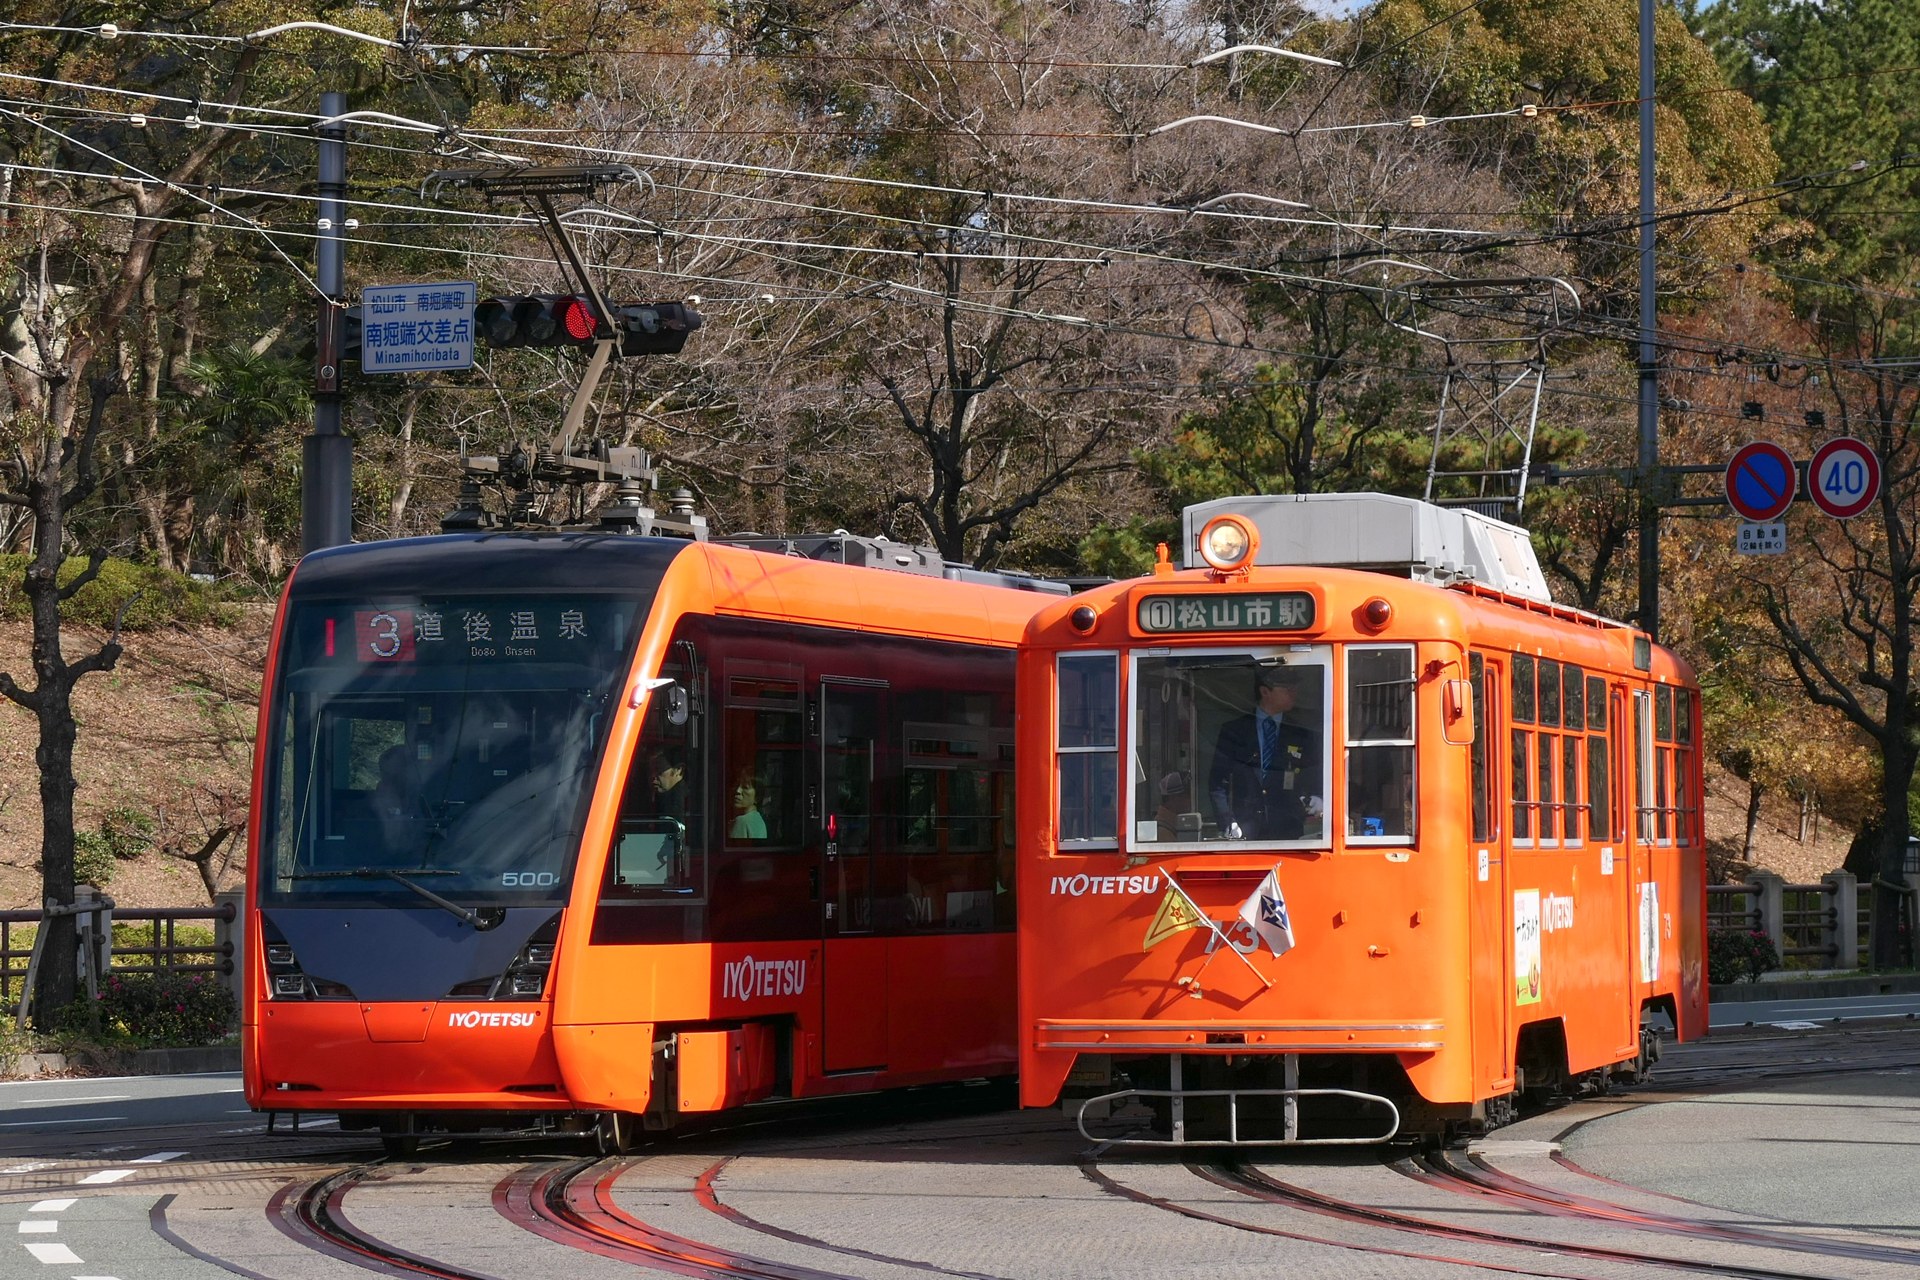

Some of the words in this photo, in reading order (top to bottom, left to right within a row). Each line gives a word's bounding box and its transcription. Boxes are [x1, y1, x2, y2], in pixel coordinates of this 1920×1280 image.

[371, 294, 406, 314] 松山市
[417, 291, 465, 312] 南堀端町
[366, 318, 469, 348] 南堀端交差点
[375, 347, 459, 364] Minamihoribata
[1825, 460, 1863, 495] 40
[414, 609, 588, 642] 道後温泉
[1178, 597, 1308, 629] 松山市駅
[370, 614, 401, 657] 3
[504, 645, 536, 656] Onsen
[1050, 873, 1159, 897] IYOTETSU
[1542, 891, 1574, 934] IYOTETSU
[723, 955, 805, 1002] IYOTETSU
[448, 1010, 535, 1029] IYOTETSU
